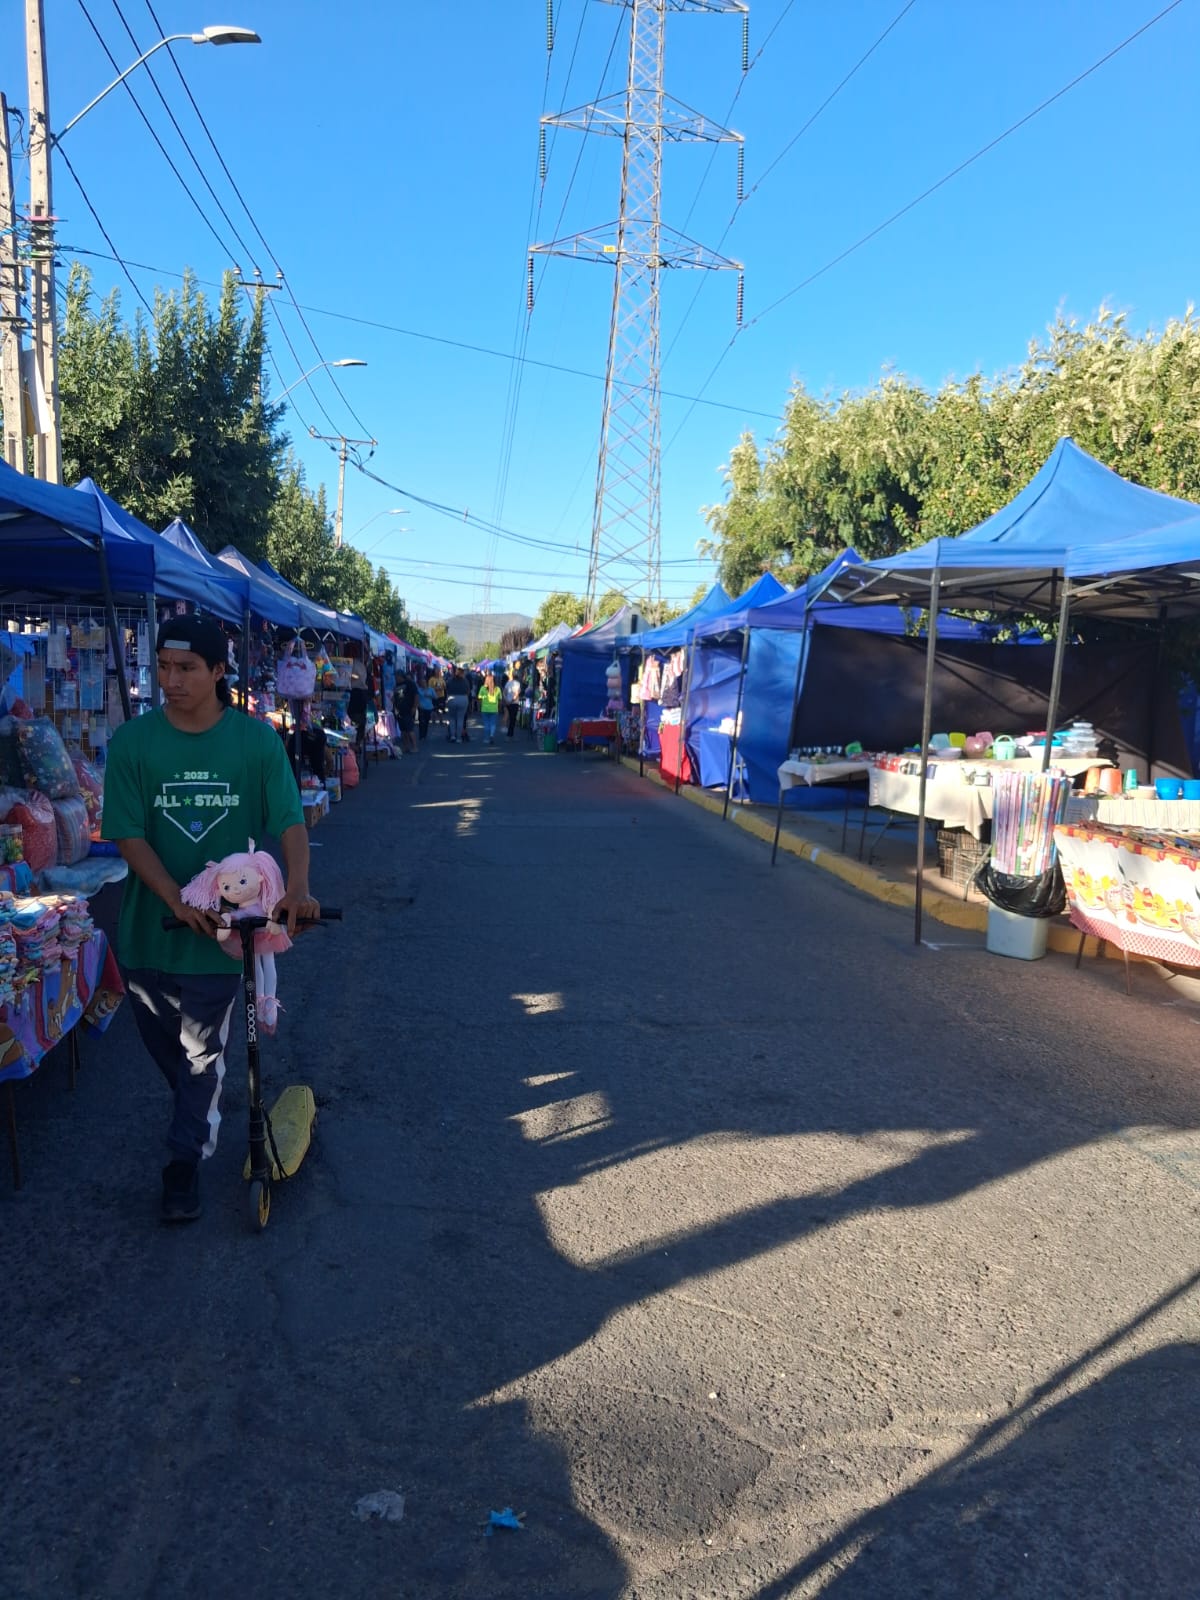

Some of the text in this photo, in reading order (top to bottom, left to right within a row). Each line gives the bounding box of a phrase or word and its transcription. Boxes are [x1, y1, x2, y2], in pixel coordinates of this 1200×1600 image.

[184, 771, 208, 780] 2023
[153, 794, 240, 807] ALL STARS
